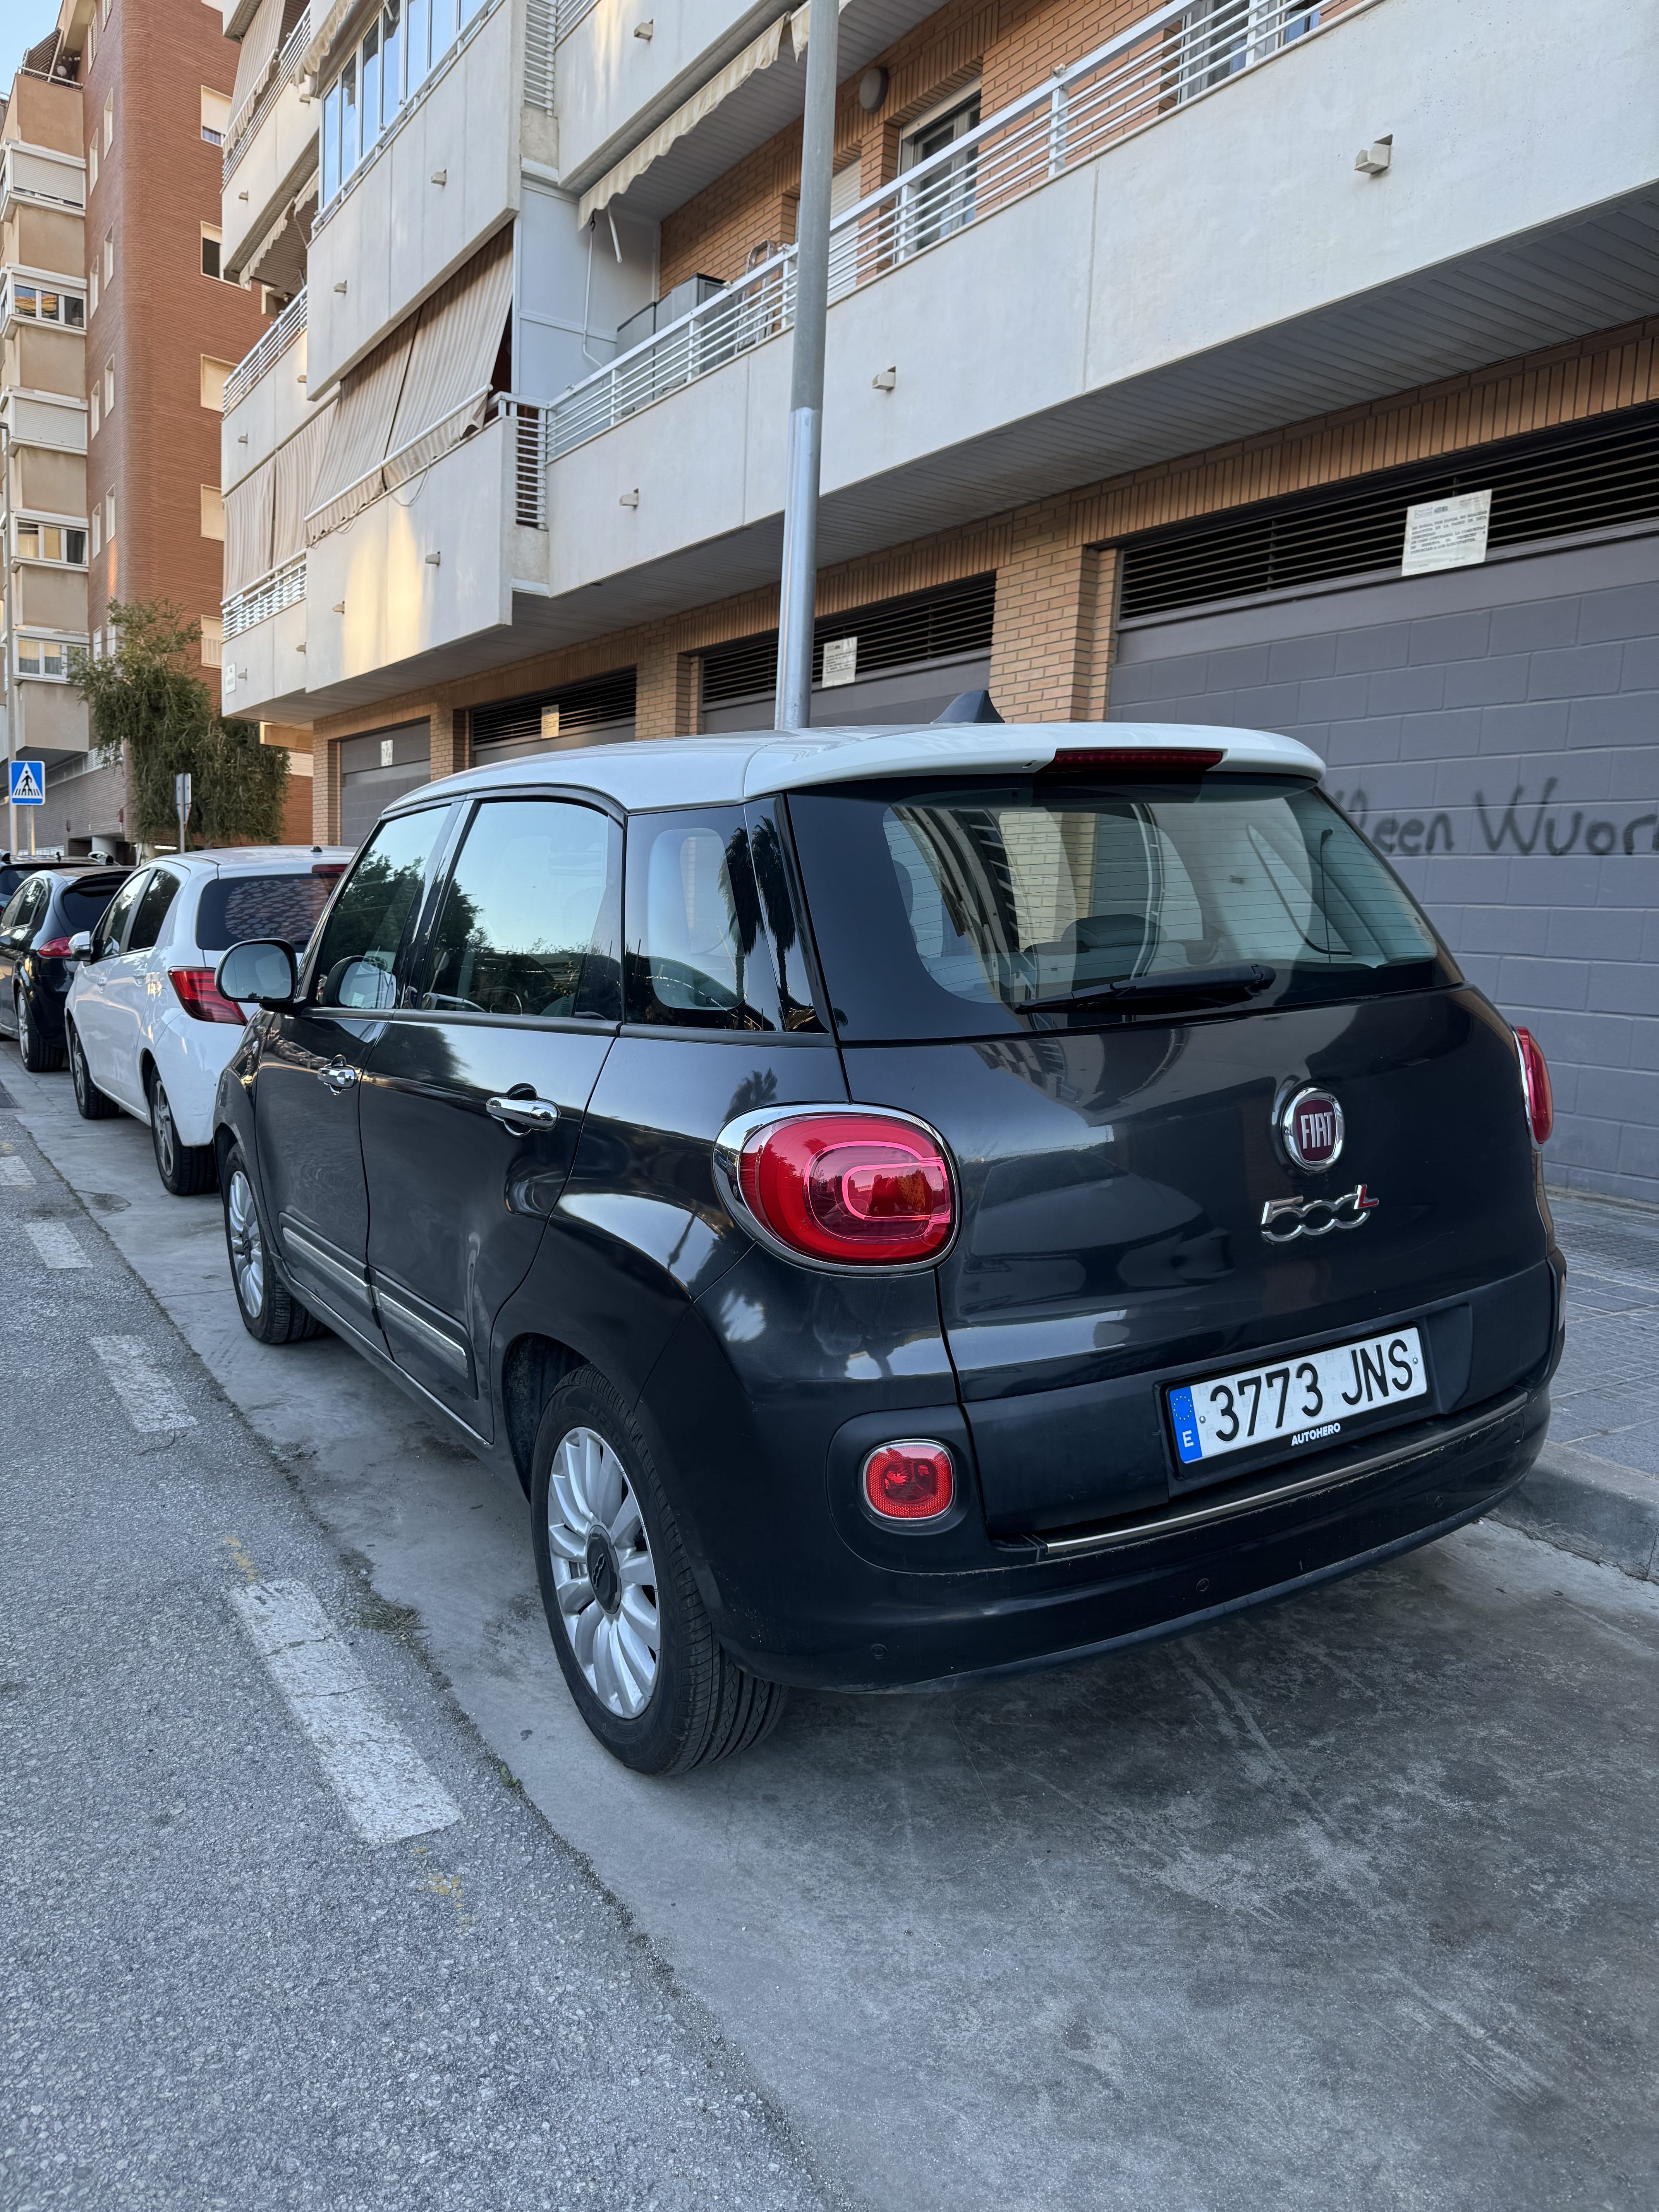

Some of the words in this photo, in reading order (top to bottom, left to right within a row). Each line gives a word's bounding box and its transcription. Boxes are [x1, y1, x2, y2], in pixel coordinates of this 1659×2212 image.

[1475, 776, 1659, 856] Wuor
[1300, 1111, 1333, 1149] FIAT
[1261, 1183, 1380, 1243] 500L
[1210, 1362, 1324, 1442] 3773
[1341, 1339, 1413, 1406] JNS
[1182, 1430, 1195, 1448] E
[1291, 1422, 1341, 1446] AUTOHERO
